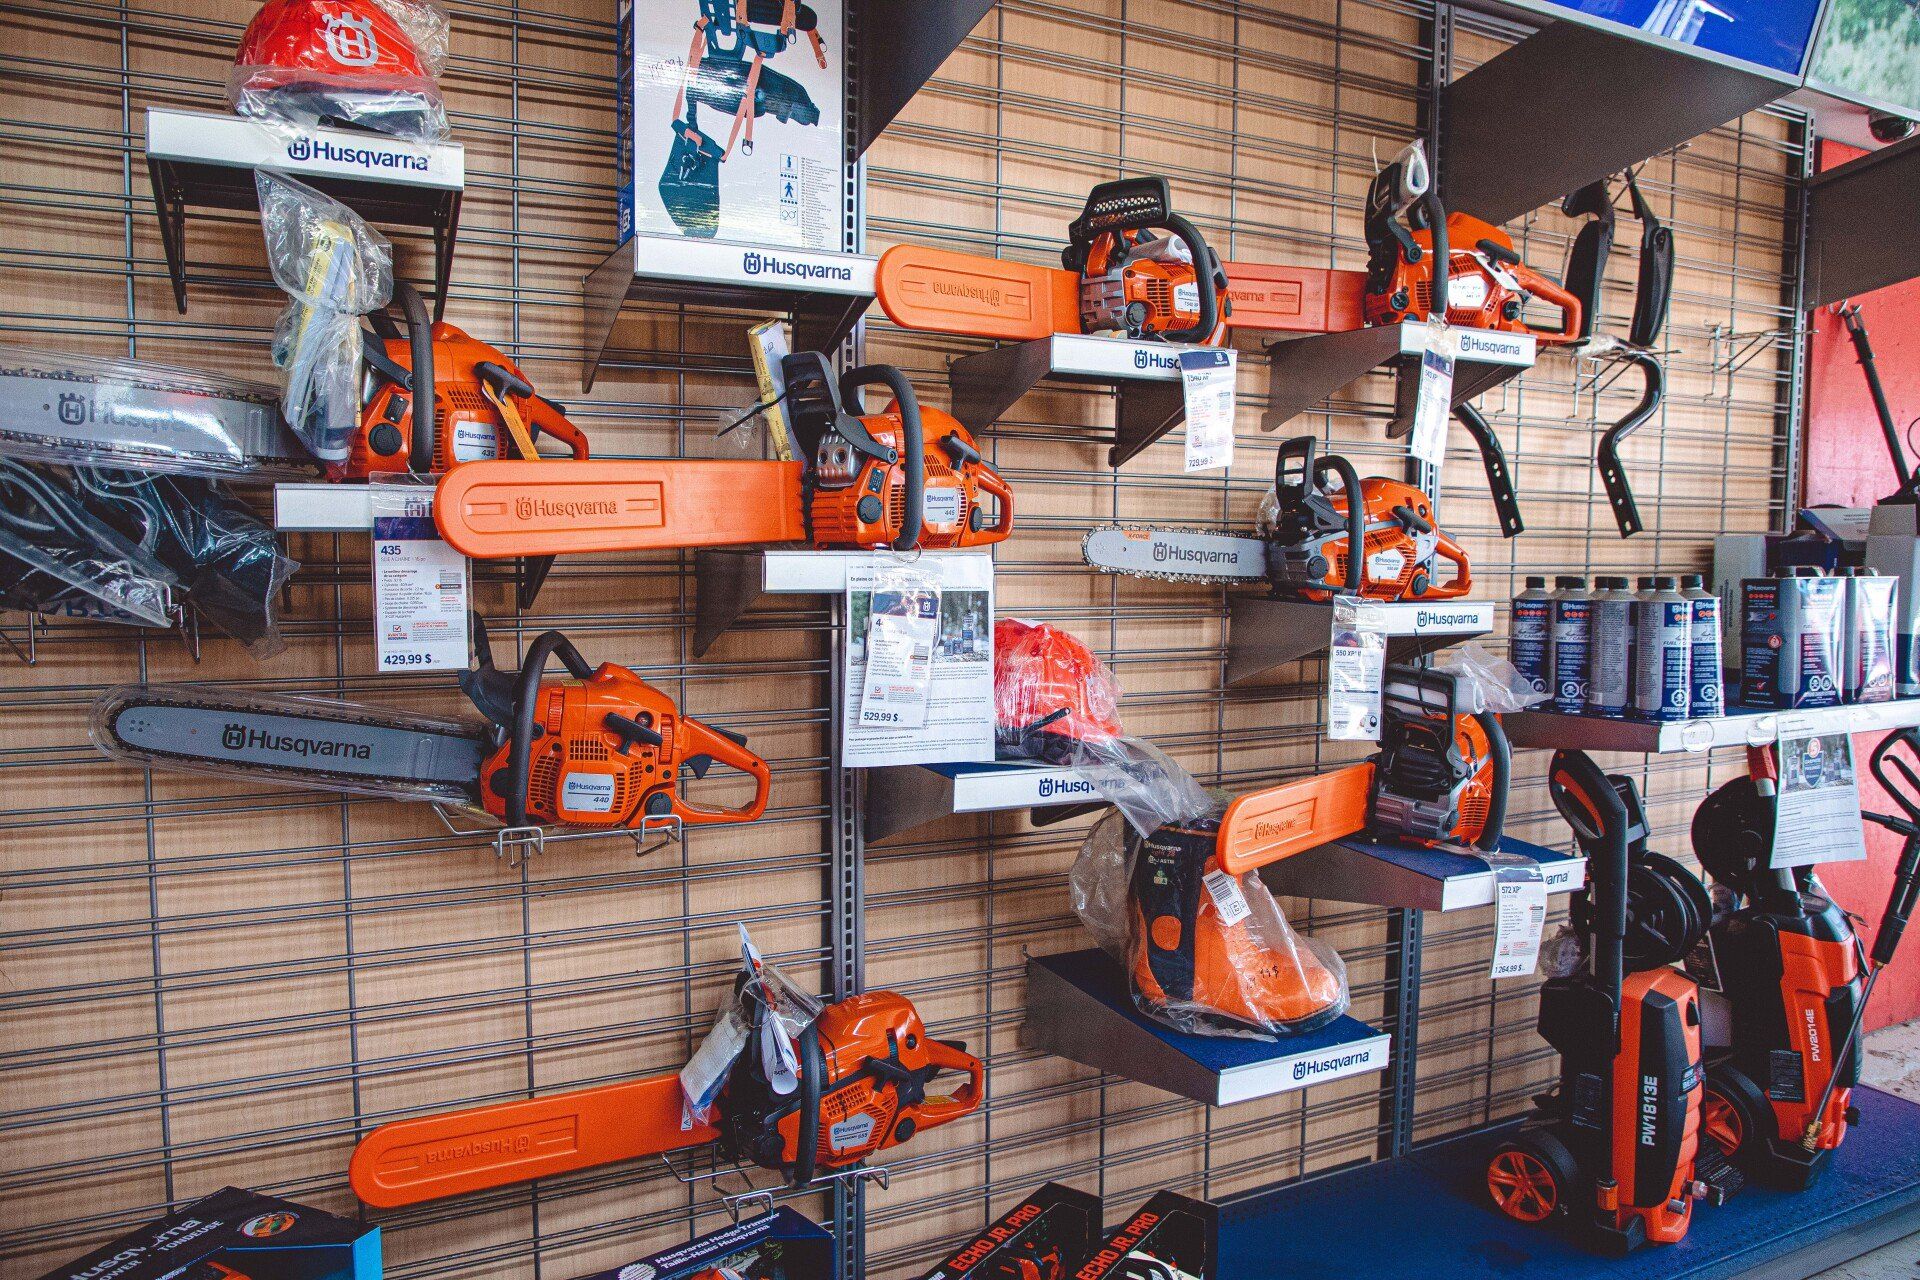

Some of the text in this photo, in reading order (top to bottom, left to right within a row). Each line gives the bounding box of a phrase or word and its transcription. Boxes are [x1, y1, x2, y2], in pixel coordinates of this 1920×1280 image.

[313, 141, 428, 171] Husqvarna
[763, 257, 851, 280] Husqvarna
[1471, 339, 1520, 355] Husqvarna
[465, 431, 496, 441] Husqvarna
[482, 449, 496, 457] 435
[534, 499, 618, 518] Husqvarna
[381, 545, 402, 555] 435
[1168, 546, 1238, 565] Husqvarna
[1428, 613, 1478, 627] Husqvarna
[384, 653, 432, 665] 429,99 $
[863, 711, 899, 722] 529,99 $
[248, 729, 371, 760] Husqvarna
[576, 783, 611, 791] Husqvarna
[1148, 842, 1182, 852] Husqvarna
[1501, 886, 1512, 894] 572
[1805, 1008, 1821, 1063] PW2014E
[1307, 1051, 1369, 1075] Husqvarna
[1642, 1075, 1658, 1147] PW1813E
[426, 1138, 511, 1164] Husqvarna
[157, 1220, 225, 1251] TONDEUSE
[655, 1212, 780, 1265] Husqvarna Hedge Trimmer
[948, 1203, 1042, 1272] ECHO JR. PRO
[1075, 1211, 1160, 1280] ECHO JR. PRO
[660, 1224, 771, 1270] Taille-Haies Husqvarna
